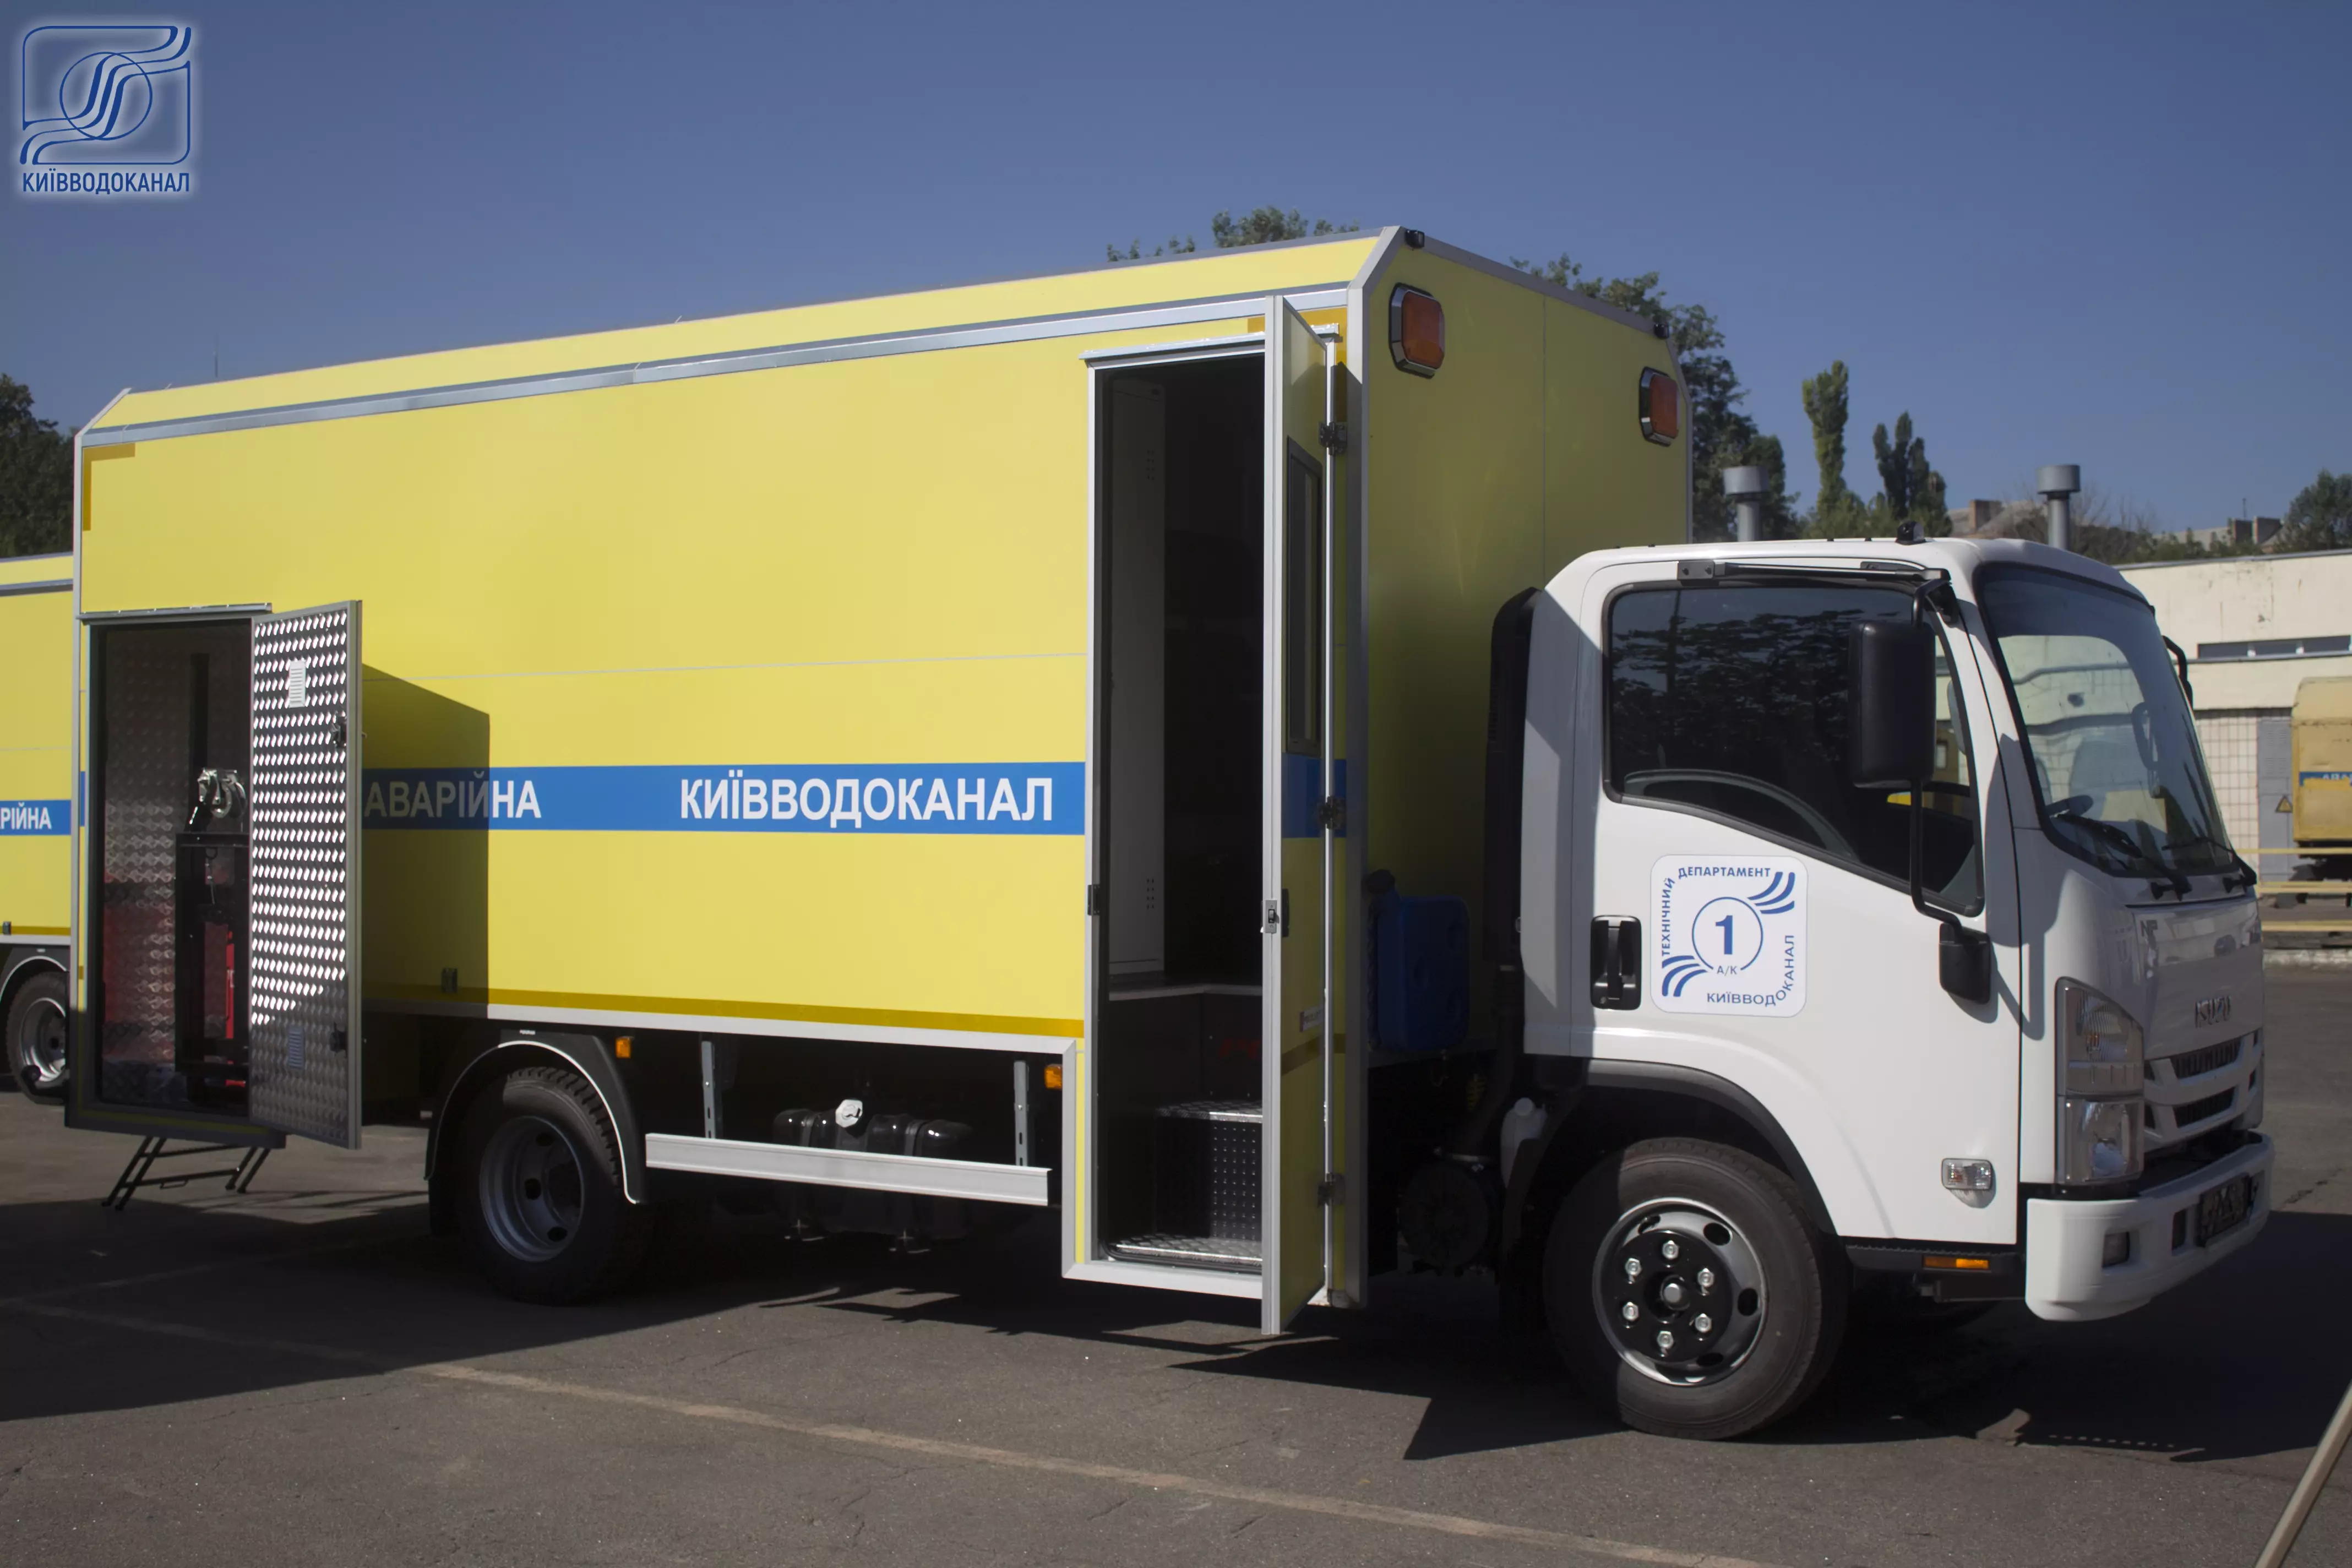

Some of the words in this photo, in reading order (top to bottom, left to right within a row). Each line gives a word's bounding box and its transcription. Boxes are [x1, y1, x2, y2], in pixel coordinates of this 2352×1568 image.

[0, 802, 52, 830] РІЙНА
[364, 771, 542, 818] АВАРІЙНА
[681, 769, 1052, 828] КИЇВВОДОКАНАЛ
[1662, 878, 1675, 956] ТЕХНІЧНИЙ
[1678, 866, 1771, 879] ДЕПАРТАМЕНТ
[1715, 914, 1733, 955] 1
[1707, 935, 1794, 1006] КИЇВВОДОКАНАЛ
